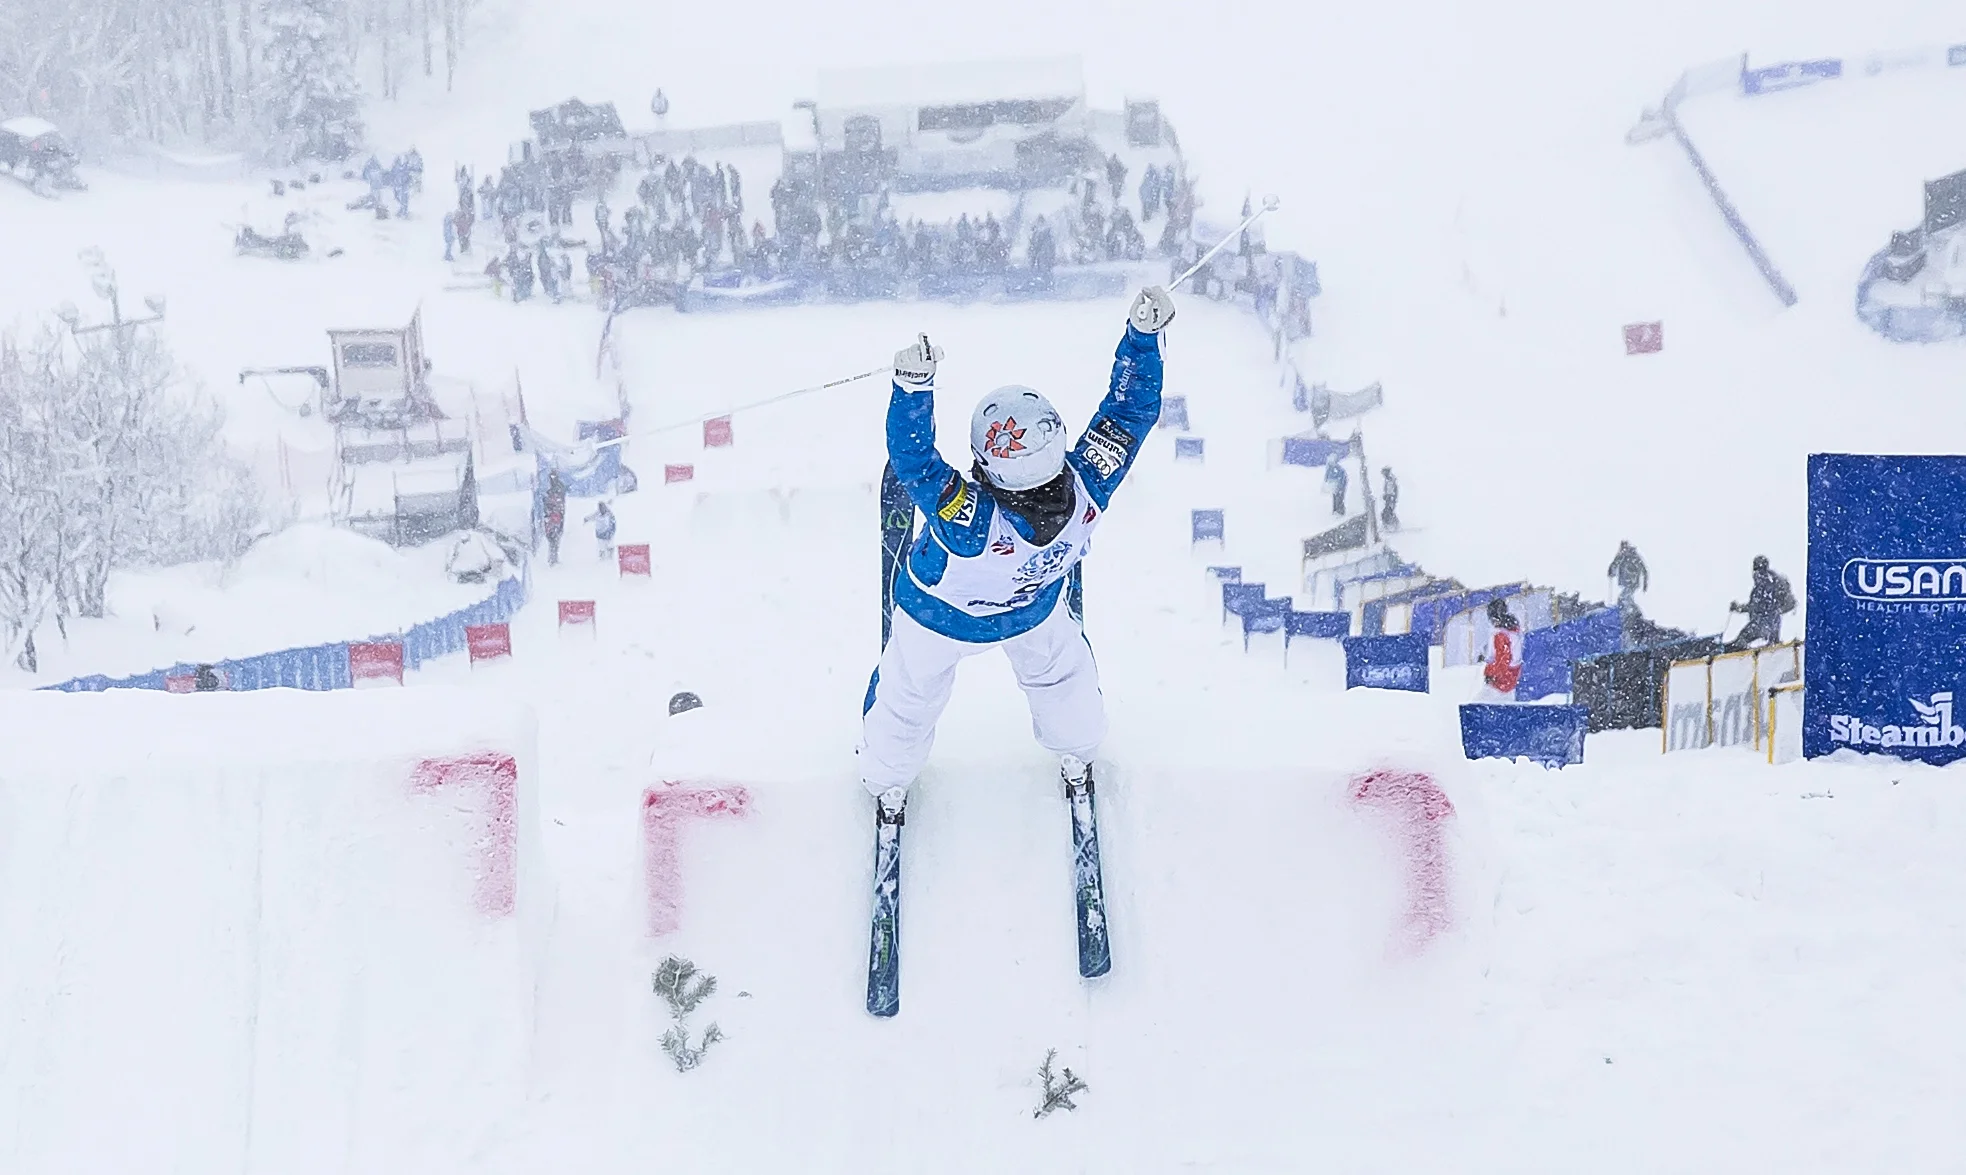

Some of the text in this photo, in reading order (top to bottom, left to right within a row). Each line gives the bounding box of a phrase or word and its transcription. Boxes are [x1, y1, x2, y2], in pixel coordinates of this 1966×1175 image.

[1087, 432, 1123, 458] Putnam
[1858, 564, 1966, 594] USAN
[1856, 601, 1912, 614] HEALTH
[1829, 693, 1966, 747] Steamb
